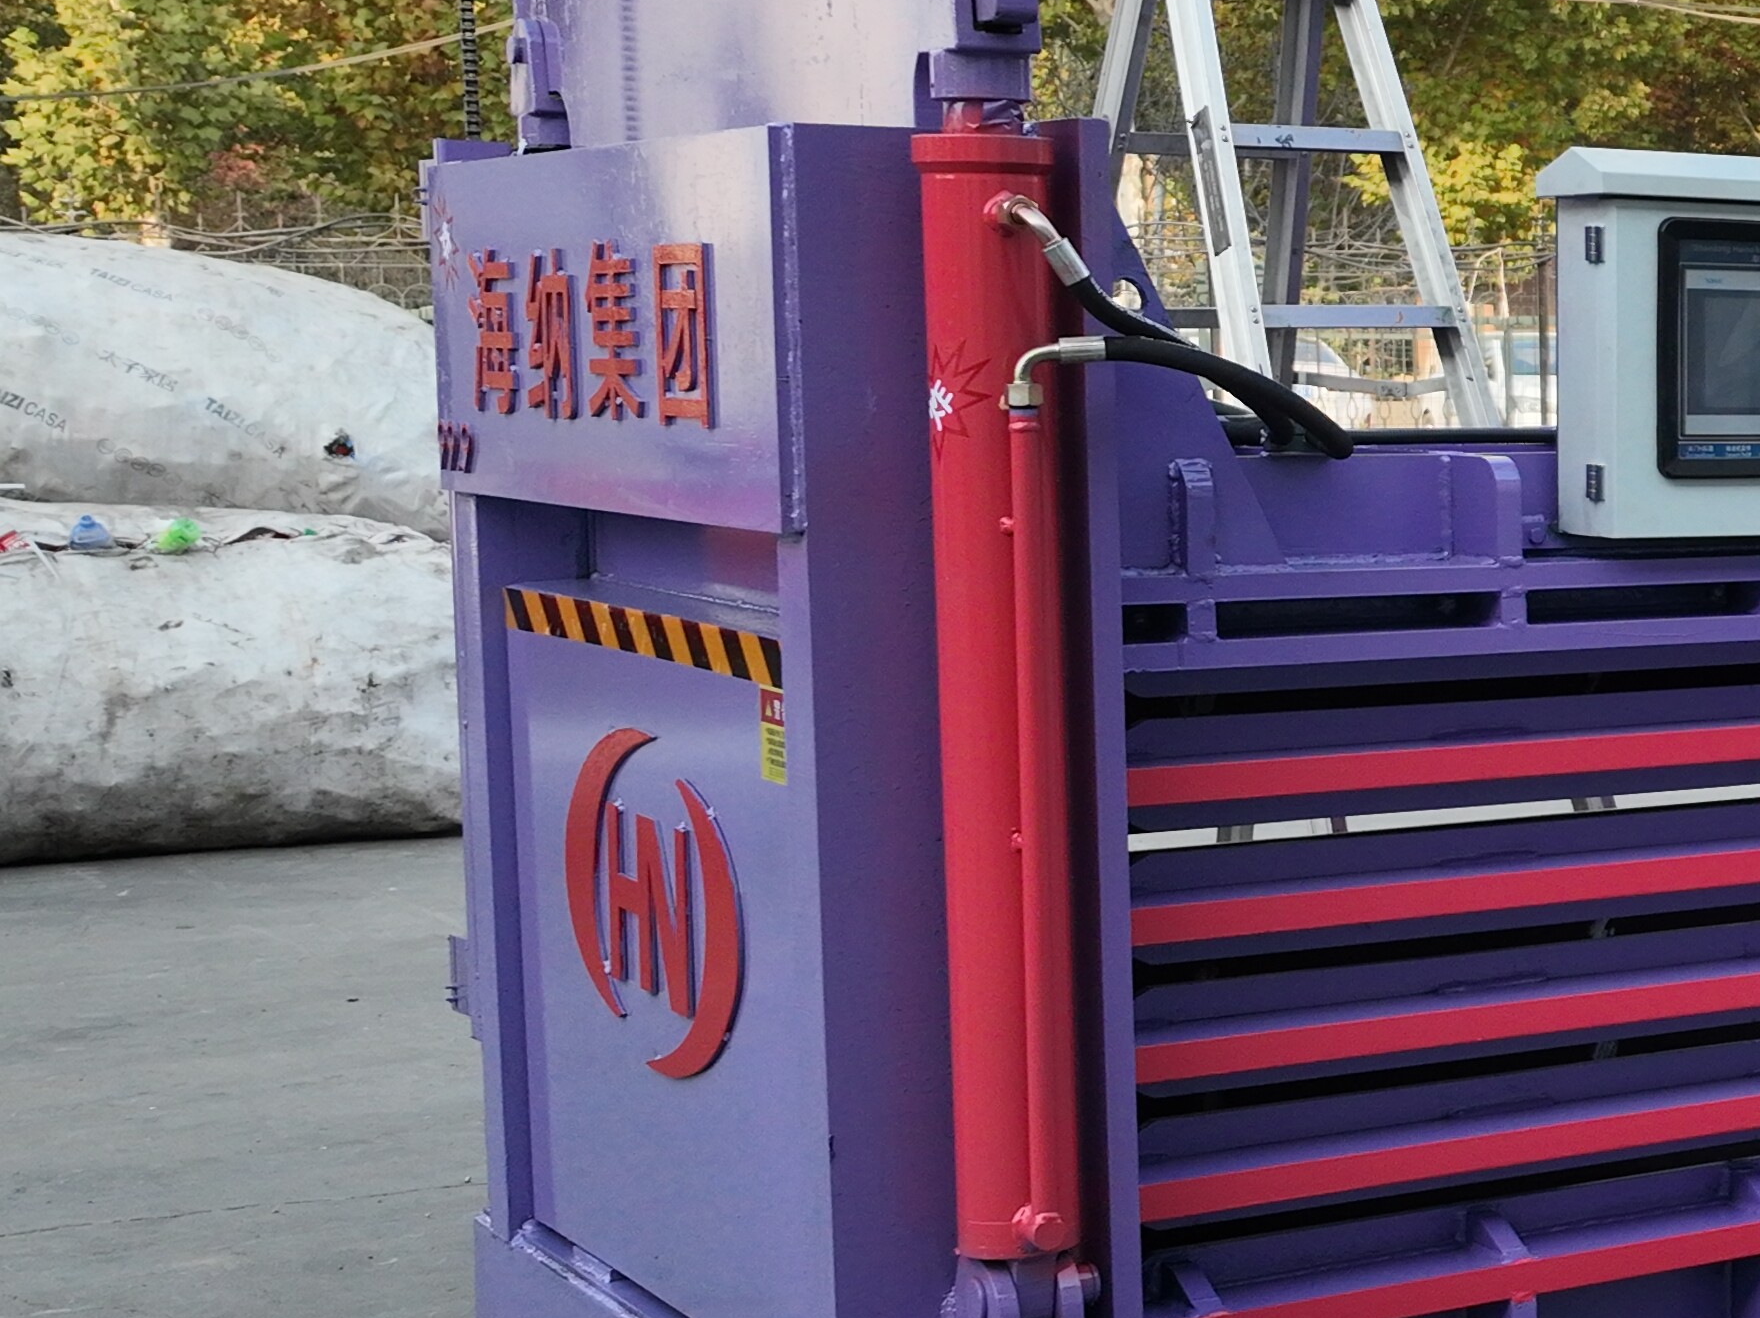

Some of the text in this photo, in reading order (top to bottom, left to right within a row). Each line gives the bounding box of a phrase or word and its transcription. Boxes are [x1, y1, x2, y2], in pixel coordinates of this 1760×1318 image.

[131, 284, 173, 302] CASA
[466, 238, 710, 430] 海纳集团
[24, 401, 67, 433] CASA
[606, 799, 696, 1019] HN
